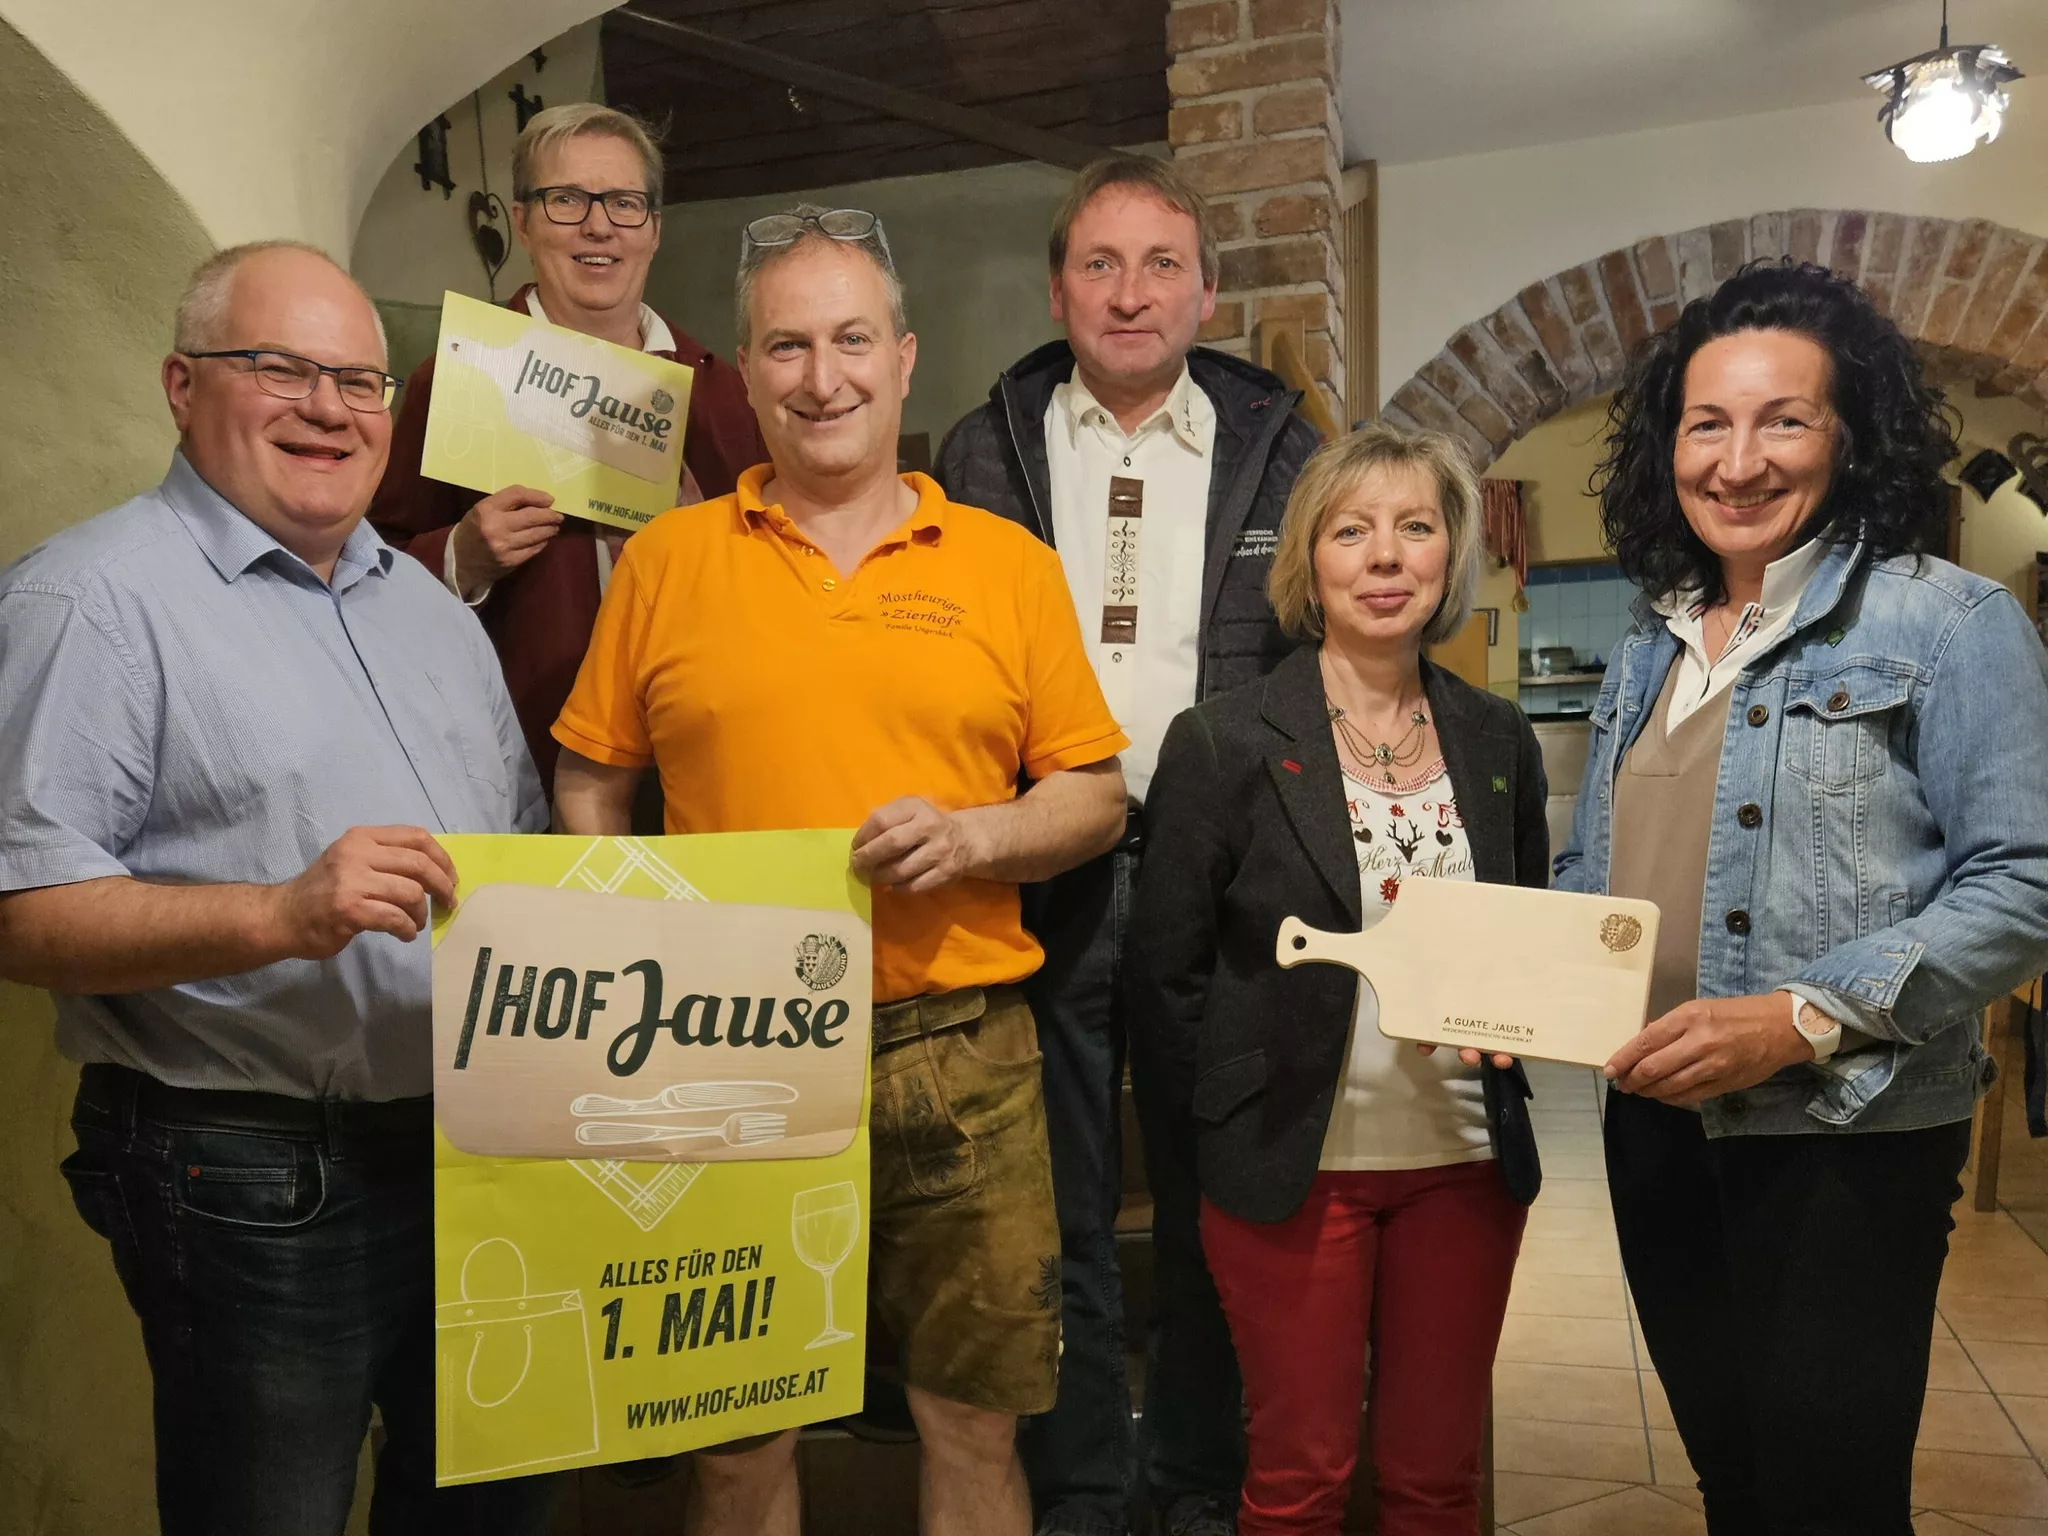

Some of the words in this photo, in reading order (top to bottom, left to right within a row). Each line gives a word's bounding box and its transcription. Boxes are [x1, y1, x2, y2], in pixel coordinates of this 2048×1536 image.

[527, 359, 580, 398] HOF
[570, 375, 672, 438] Jause
[588, 416, 610, 431] ALLES
[625, 431, 640, 442] DEN
[649, 438, 667, 453] MAI
[877, 590, 968, 615] Mostheuriger
[1358, 844, 1402, 878] Herz
[811, 953, 847, 990] BAUERNBUND
[485, 964, 615, 1040] HOF
[606, 958, 850, 1077] Jause
[1444, 1016, 1451, 1025] A
[1454, 1018, 1489, 1030] GUATE
[600, 1258, 669, 1288] ALLES
[674, 1249, 715, 1282] FÜR
[721, 1244, 763, 1274] DEN
[600, 1297, 634, 1361] 1.
[657, 1276, 776, 1356] MAI!
[626, 1367, 830, 1430] WWW.HOFJAUSE.AT
